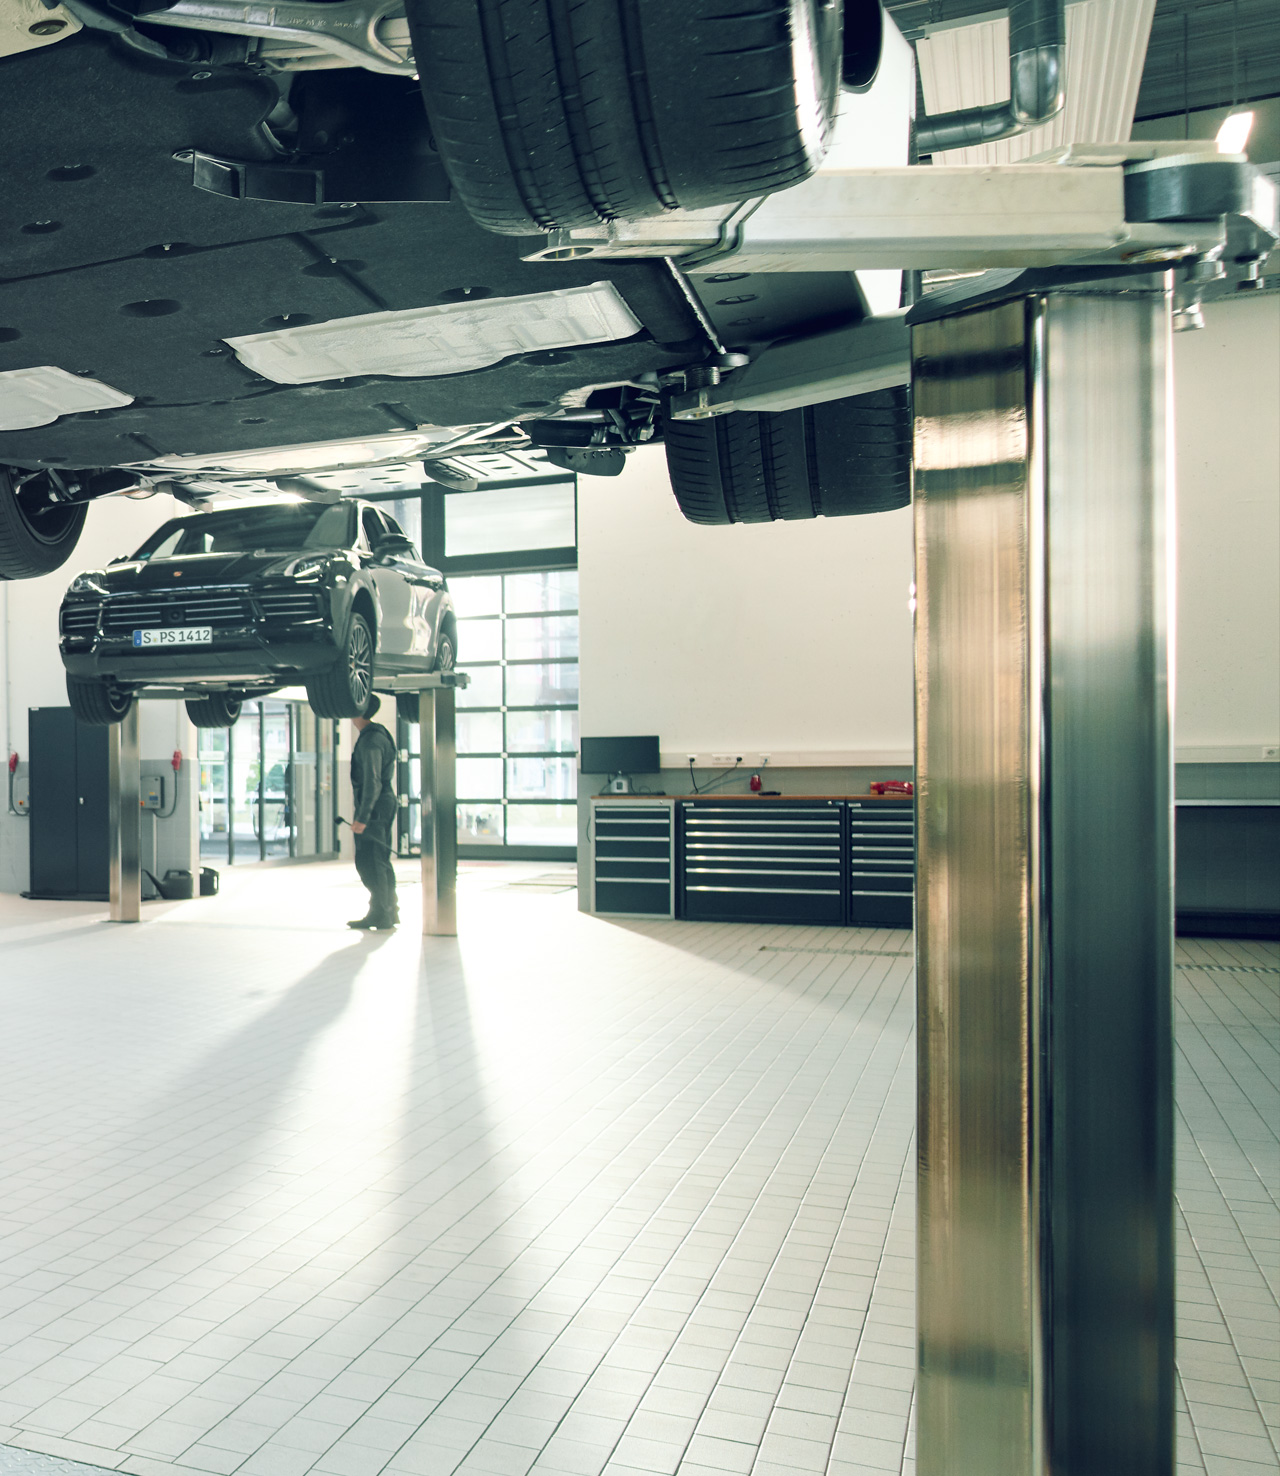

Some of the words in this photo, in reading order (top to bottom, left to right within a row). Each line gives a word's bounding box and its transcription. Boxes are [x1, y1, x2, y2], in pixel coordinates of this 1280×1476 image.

[143, 631, 152, 644] S
[159, 630, 176, 643] PS
[178, 629, 210, 642] 1412
